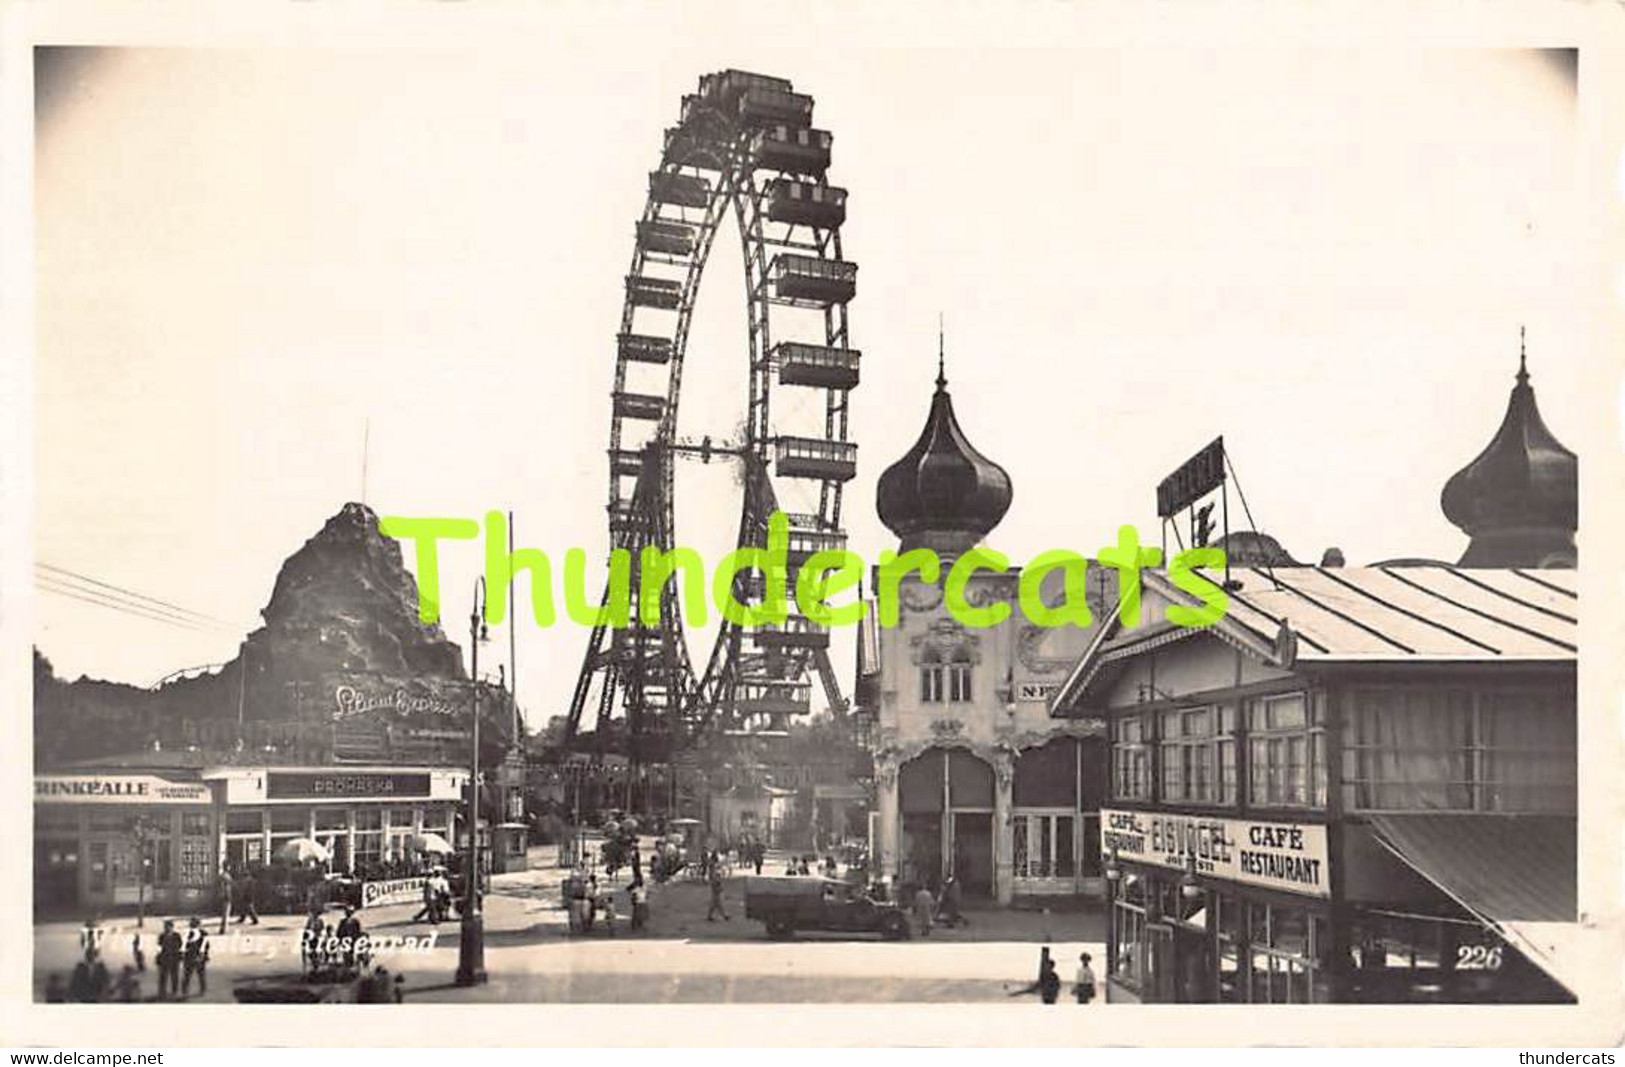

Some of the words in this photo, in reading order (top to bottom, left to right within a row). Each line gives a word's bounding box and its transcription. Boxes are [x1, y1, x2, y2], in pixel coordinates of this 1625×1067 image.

[1152, 818, 1232, 863] EISVOGEL
[1249, 823, 1304, 850] CAFÉ
[1240, 850, 1320, 886] RESTAURANT
